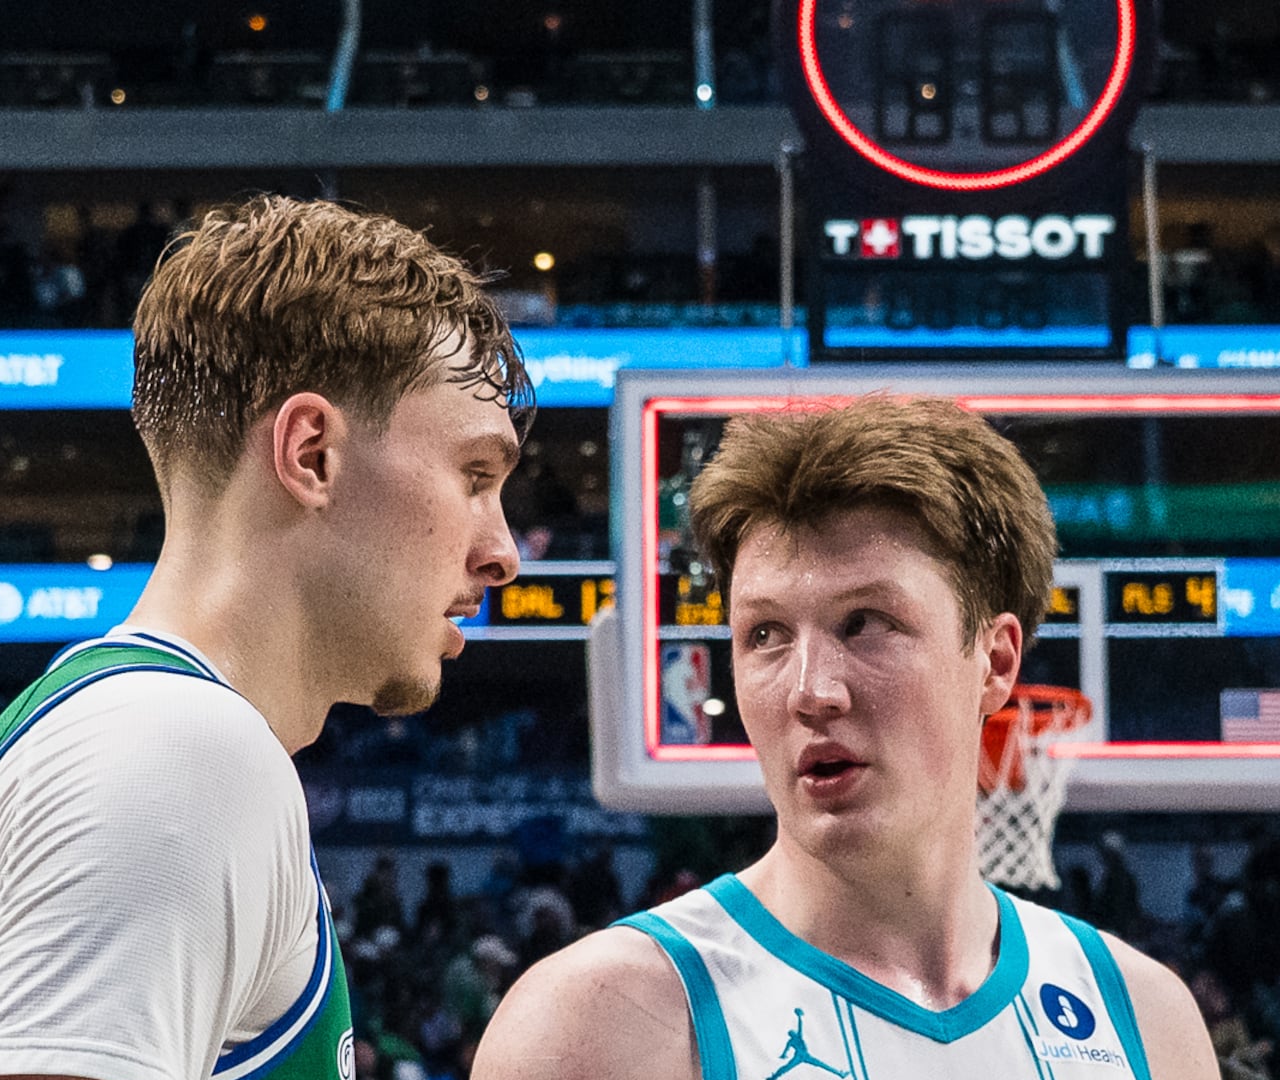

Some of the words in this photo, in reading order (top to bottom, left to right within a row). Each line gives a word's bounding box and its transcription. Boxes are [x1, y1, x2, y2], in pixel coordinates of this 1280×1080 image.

[902, 214, 1116, 259] TISSOT
[525, 355, 618, 388] ything
[26, 586, 104, 621] AT&T
[1185, 577, 1215, 617] 4
